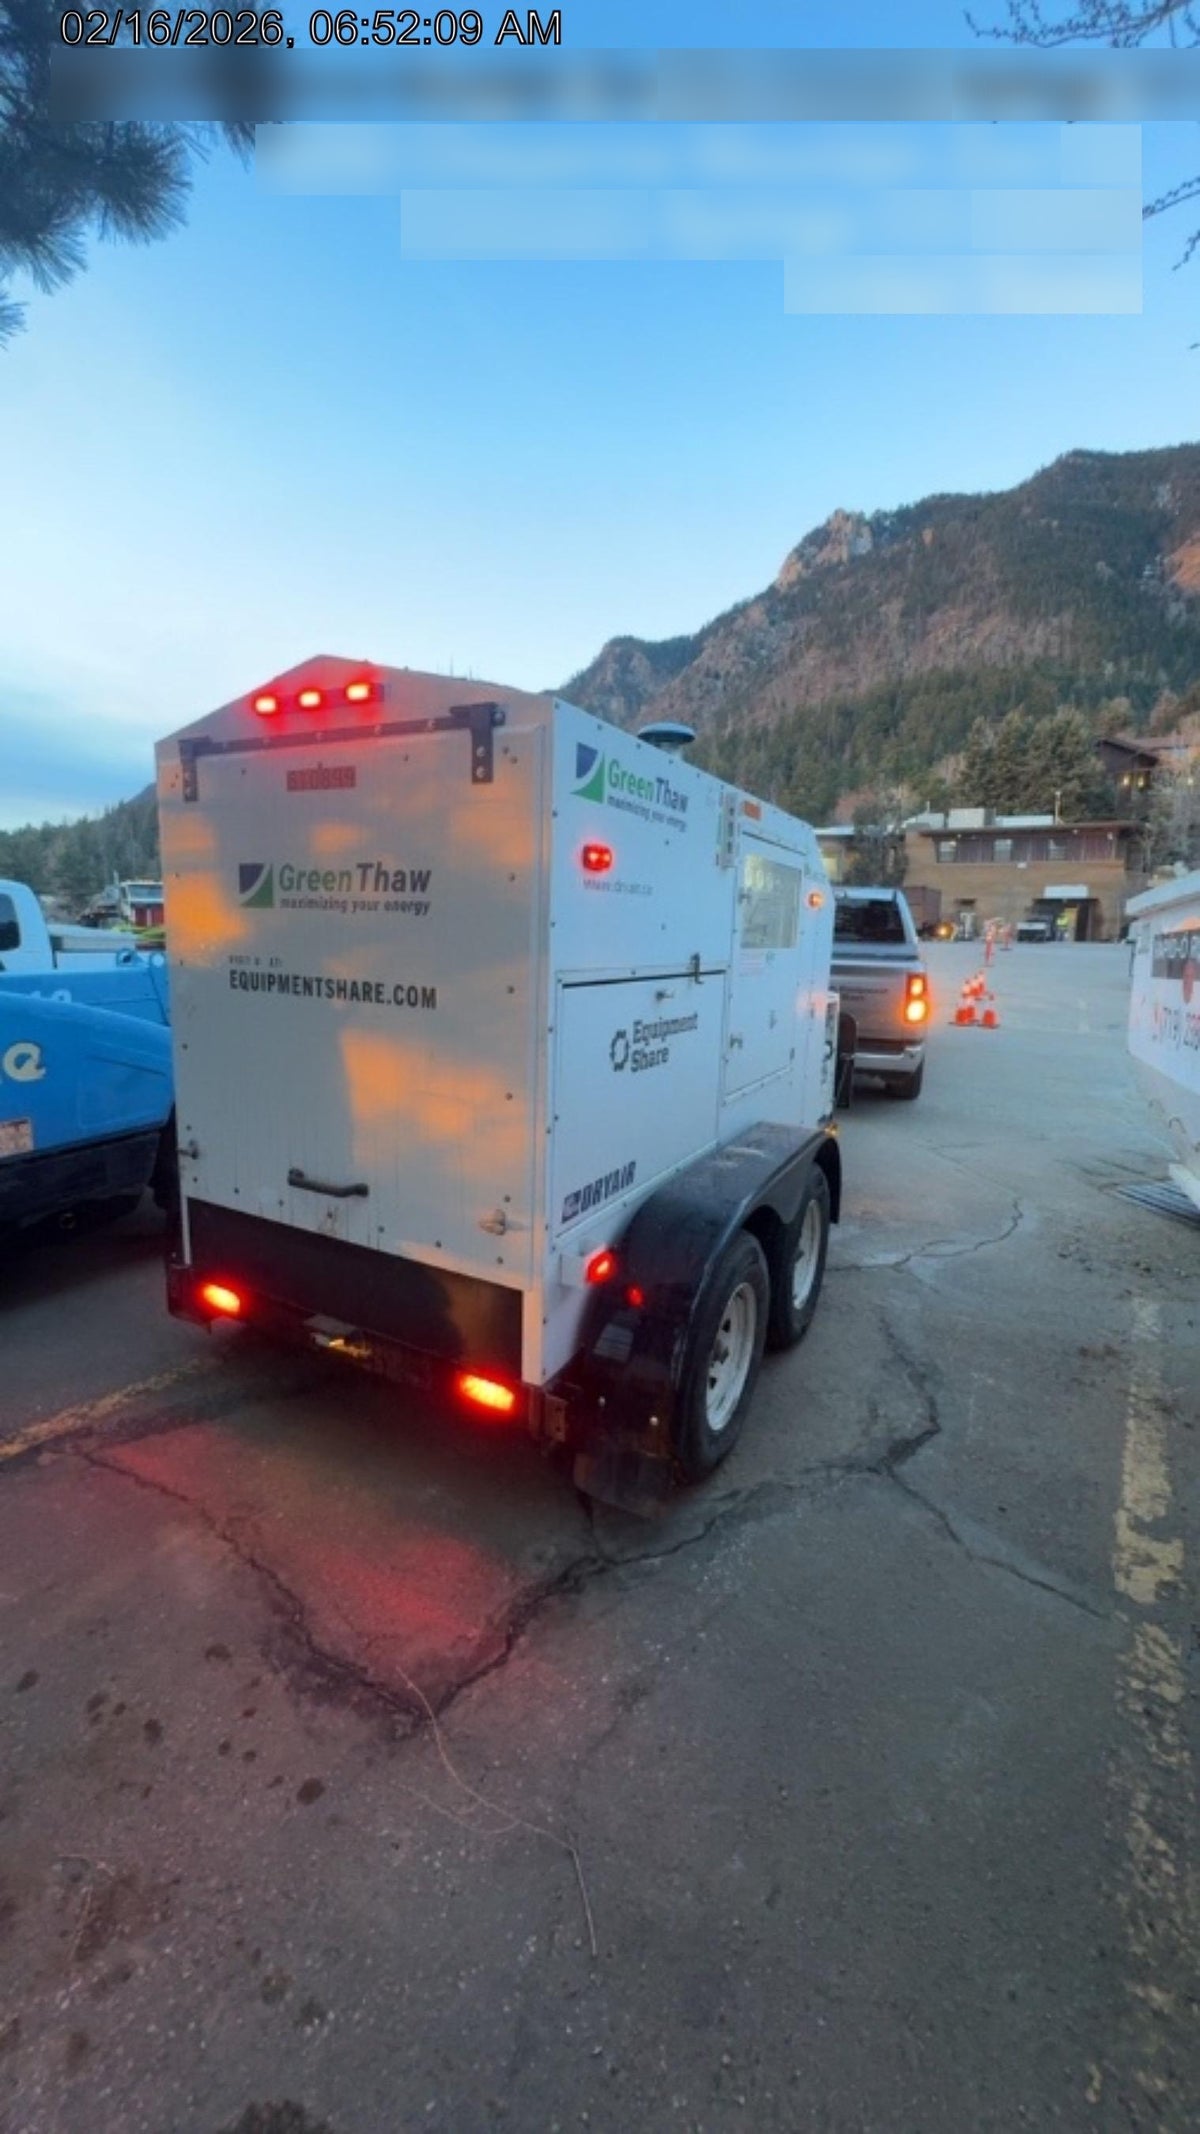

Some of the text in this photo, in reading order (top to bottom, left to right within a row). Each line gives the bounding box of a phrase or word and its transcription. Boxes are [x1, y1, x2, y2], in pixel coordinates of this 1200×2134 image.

[279, 896, 431, 916] maximizing your energy
[229, 969, 437, 1009] EQUIPMENTSHARE.COM
[632, 1011, 698, 1046] Equipment
[630, 1047, 669, 1073] Share
